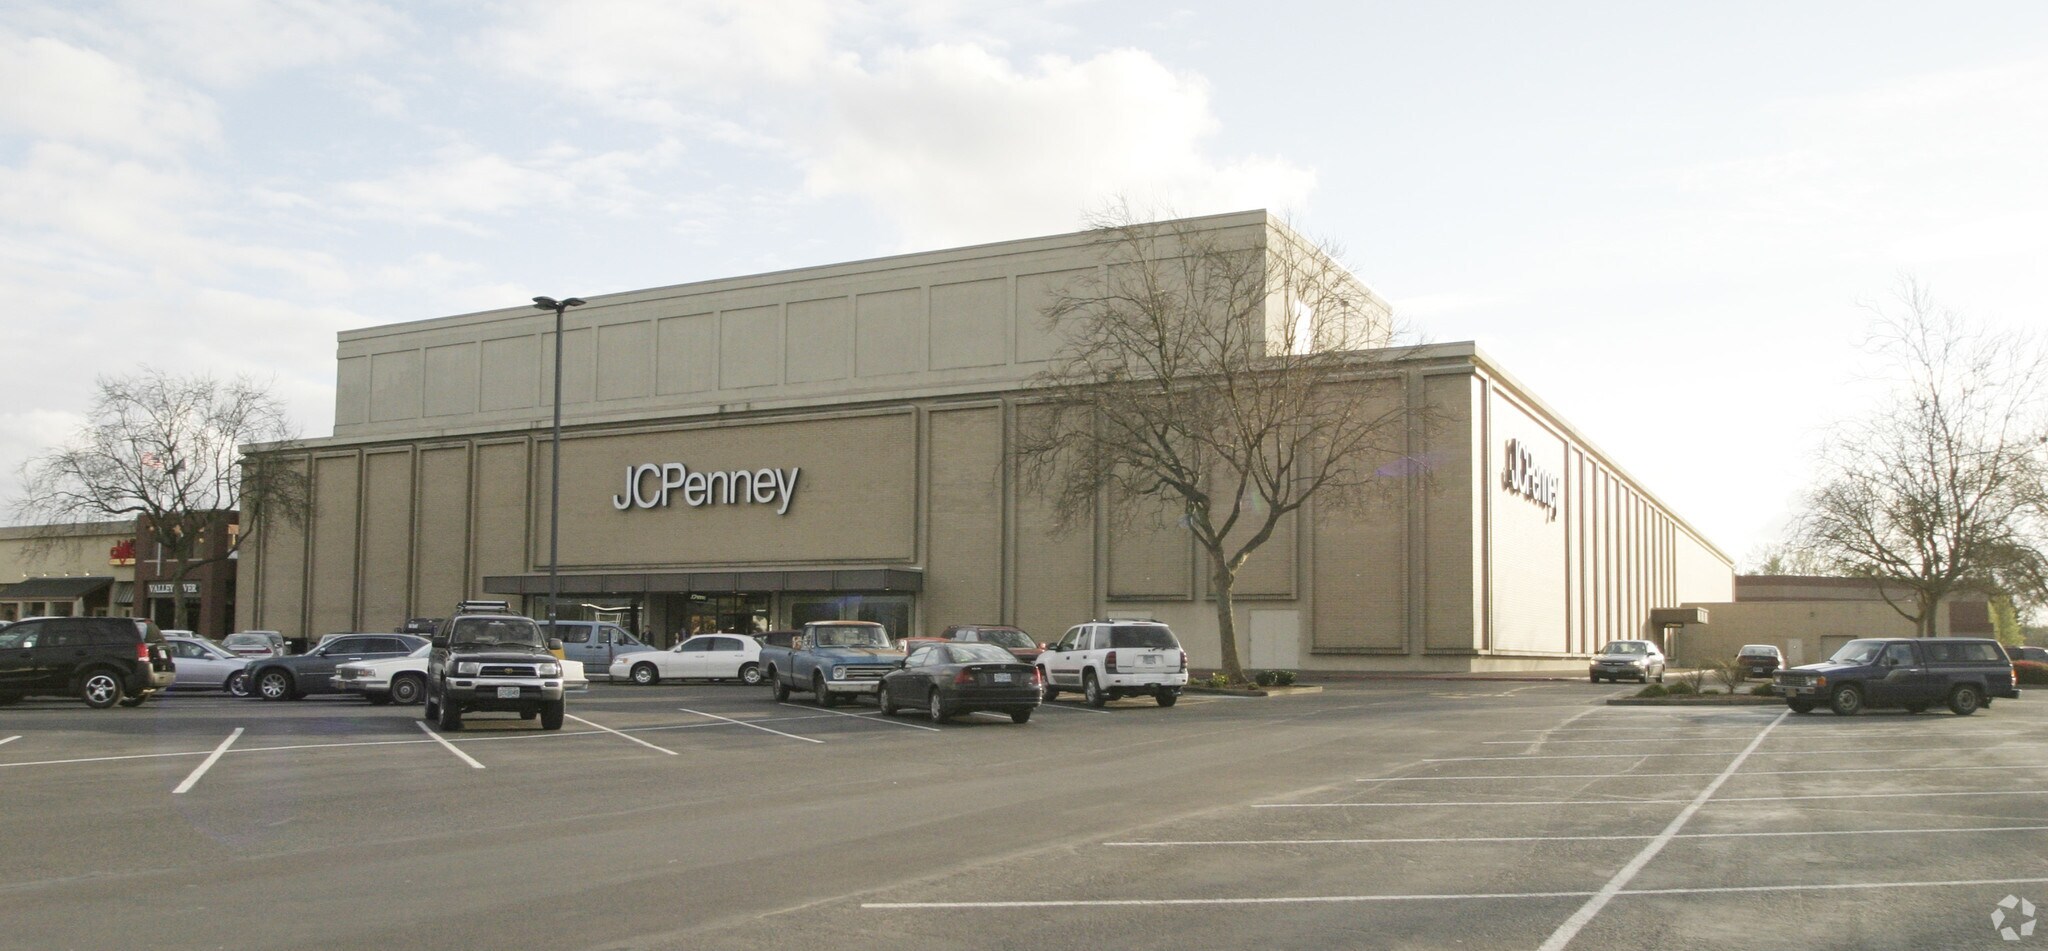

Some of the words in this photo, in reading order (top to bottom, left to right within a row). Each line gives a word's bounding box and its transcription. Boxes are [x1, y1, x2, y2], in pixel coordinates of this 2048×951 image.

[613, 462, 800, 515] JCPenney
[1506, 438, 1559, 520] JCPenney
[148, 584, 174, 593] VALLEY
[182, 583, 198, 593] VER
